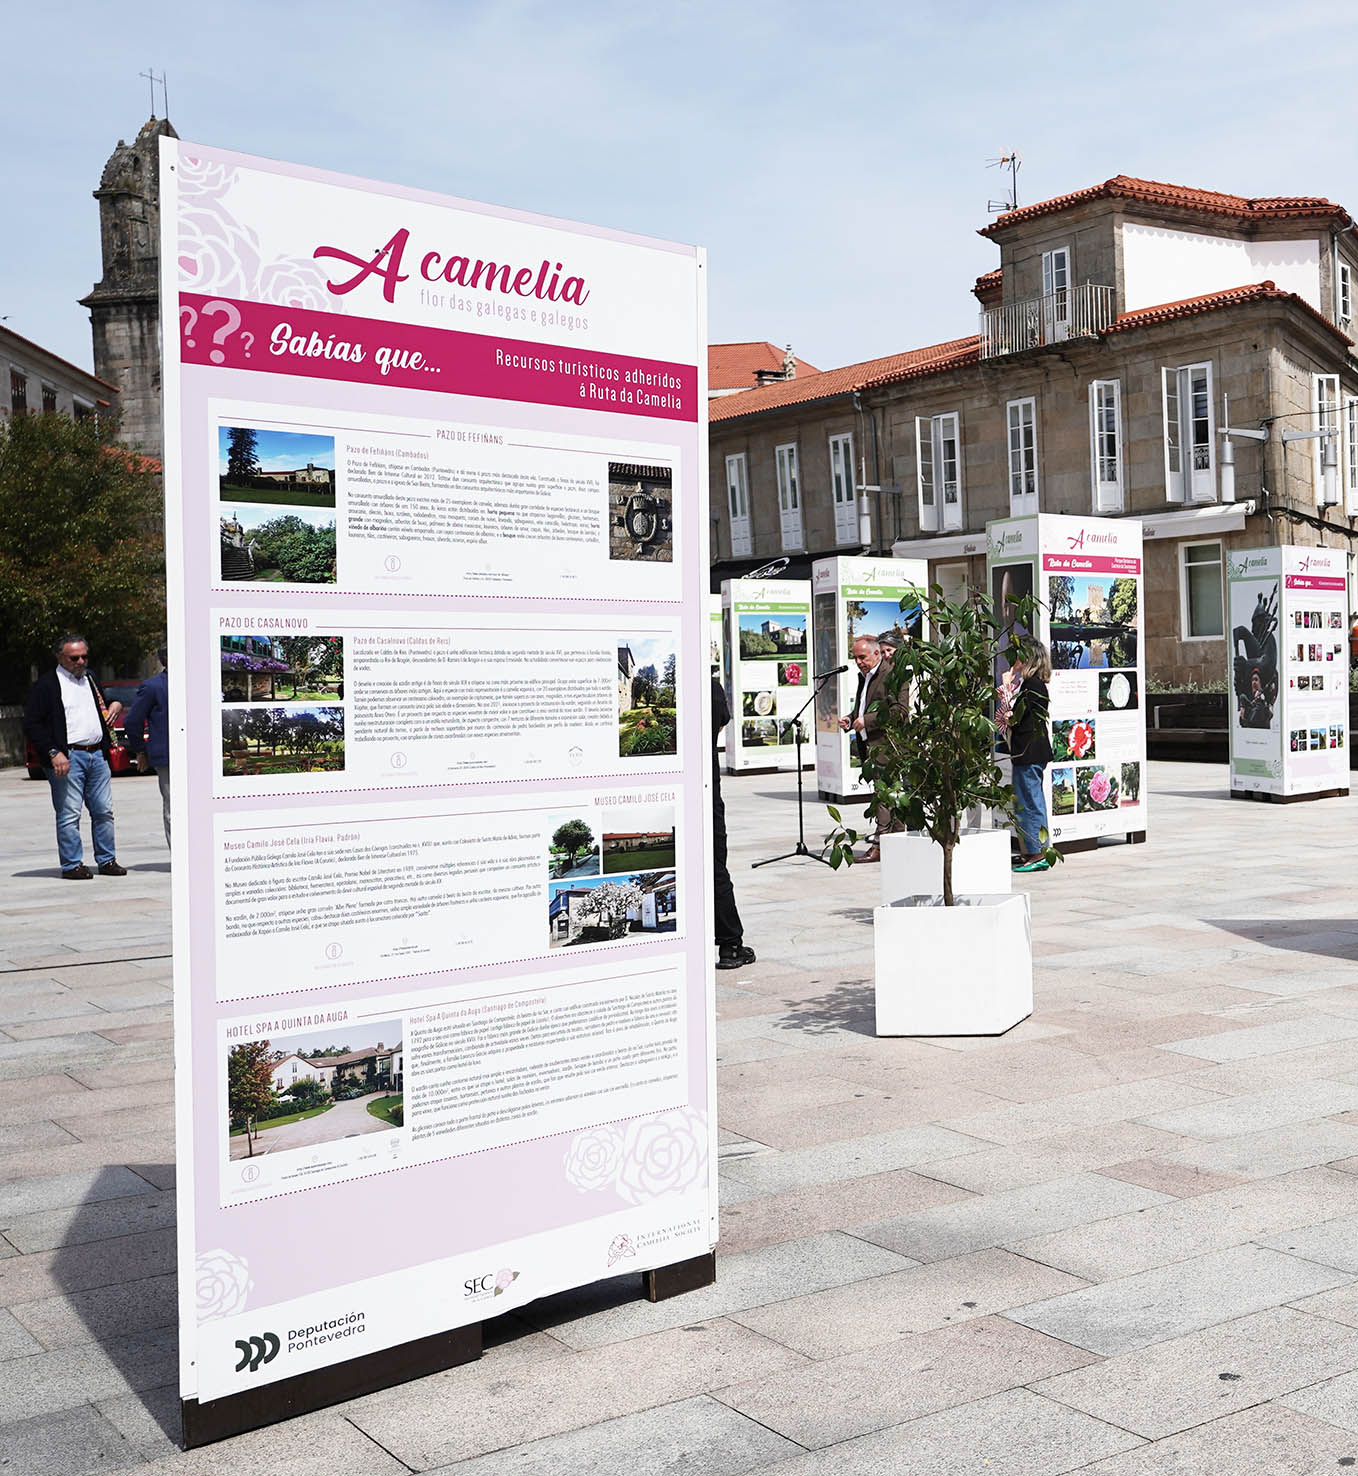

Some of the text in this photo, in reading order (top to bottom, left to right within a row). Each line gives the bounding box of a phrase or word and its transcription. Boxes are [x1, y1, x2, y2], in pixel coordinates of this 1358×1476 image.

[313, 228, 590, 306] A camelia
[420, 289, 589, 330] flor das galegas e galegos
[269, 322, 442, 376] Sabías que...
[496, 348, 682, 390] Recursos turísticos adheridos
[579, 382, 682, 410] á Ruta da Camelia
[437, 429, 455, 440] PAZO
[457, 432, 466, 441] DE
[1067, 529, 1118, 550] A camelia
[219, 617, 308, 629] PAZO DE CASALNOVO
[594, 792, 675, 806] MUSEO CAMILO JOSÉ CELA
[224, 840, 245, 850] Museo
[246, 838, 269, 849] Camilo
[269, 836, 285, 847] José
[286, 835, 300, 846] Cela
[300, 834, 314, 846] (Iria
[226, 1011, 348, 1038] HOTEL SPA A QUINTA DA AUGA
[637, 1218, 701, 1240] INTERNATIONAL
[464, 1274, 493, 1296] SEC
[287, 1310, 365, 1340] Deputación
[287, 1323, 366, 1353] Pontevedra
